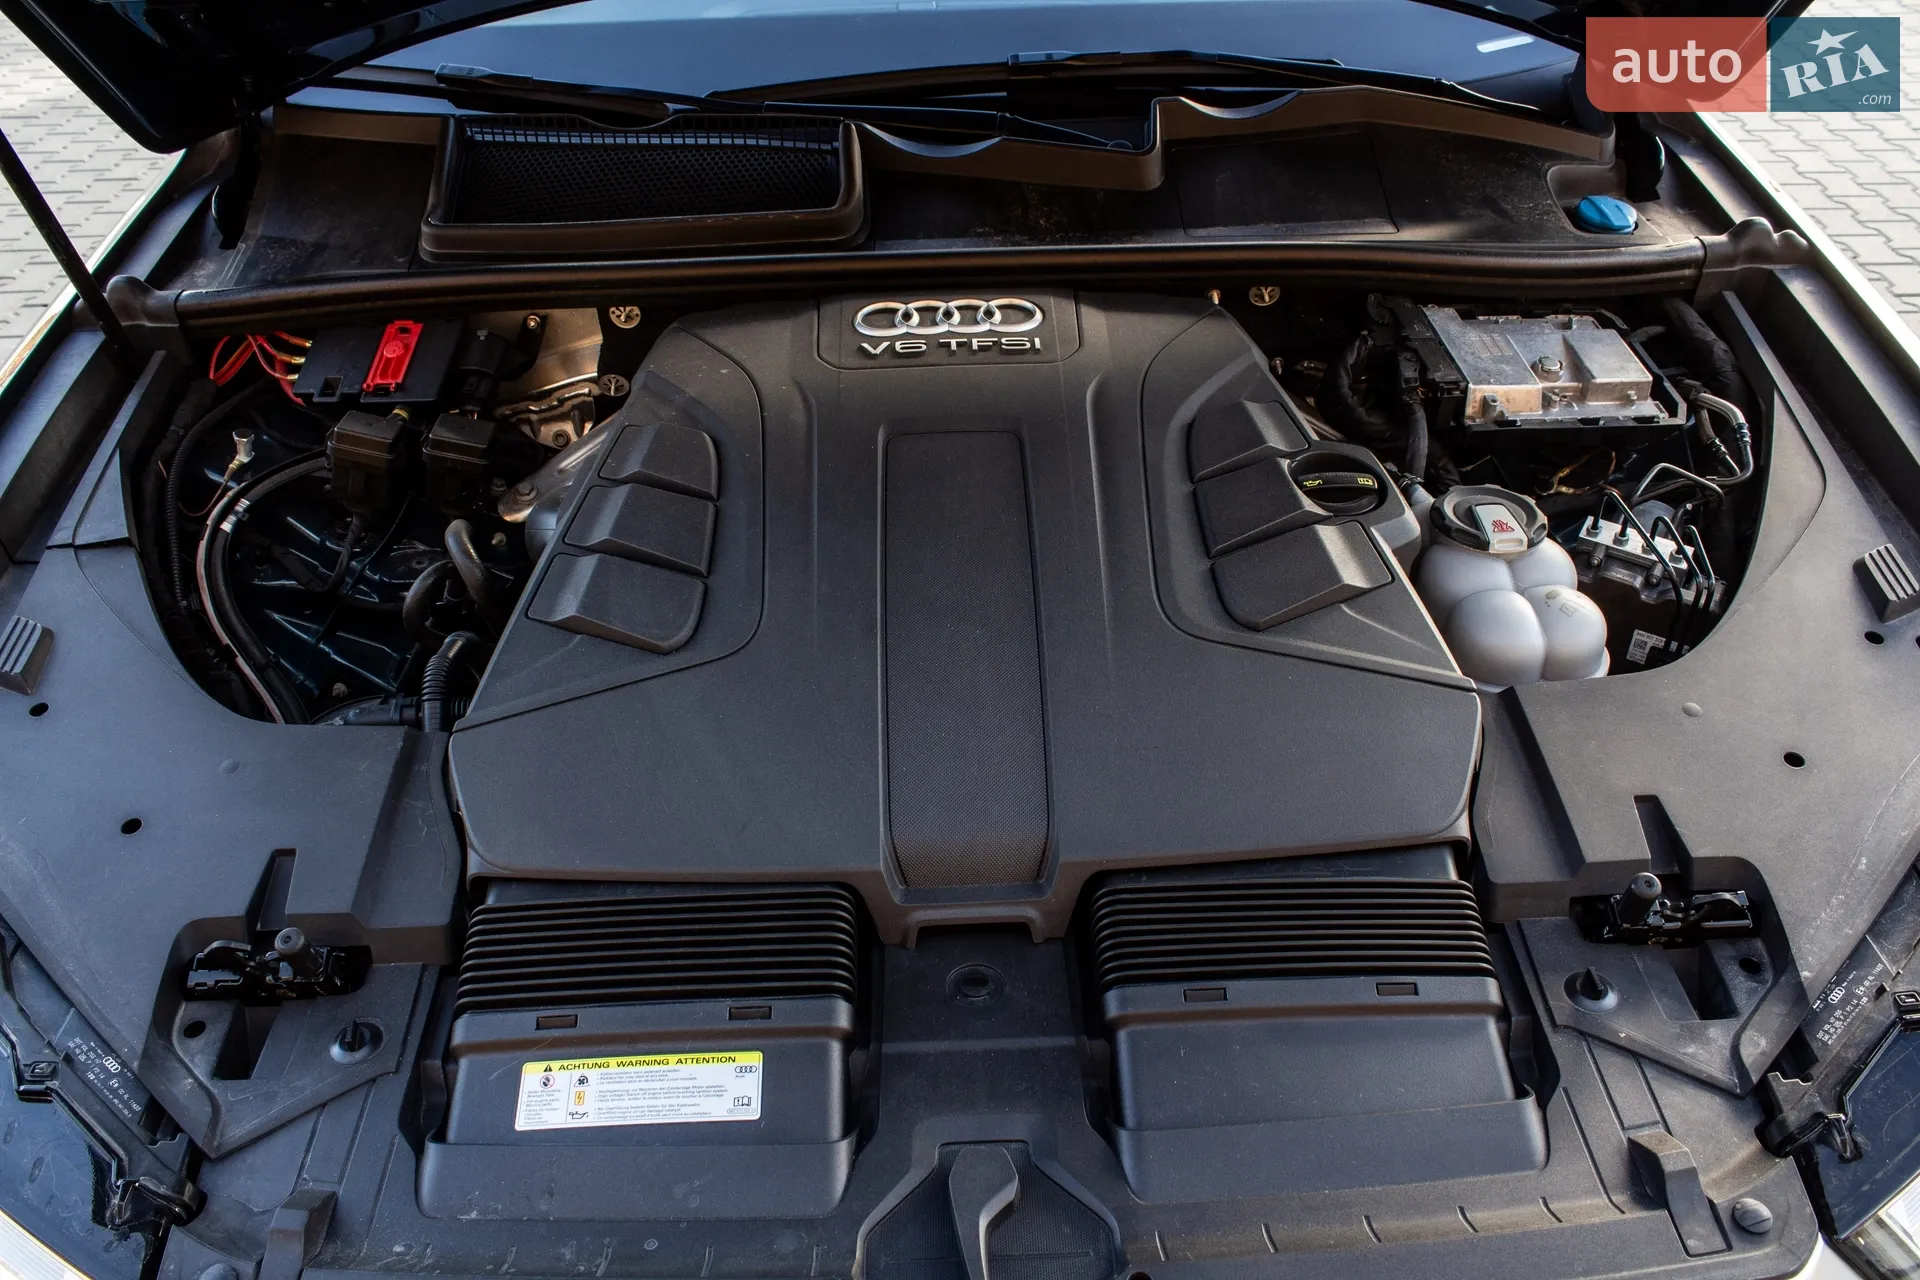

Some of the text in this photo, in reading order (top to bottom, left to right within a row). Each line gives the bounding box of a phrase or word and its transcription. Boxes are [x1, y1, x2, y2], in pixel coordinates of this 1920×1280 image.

[860, 337, 1041, 355] V6 TFSI
[558, 1056, 736, 1071] ACHTUNG WARNING ATTENTION
